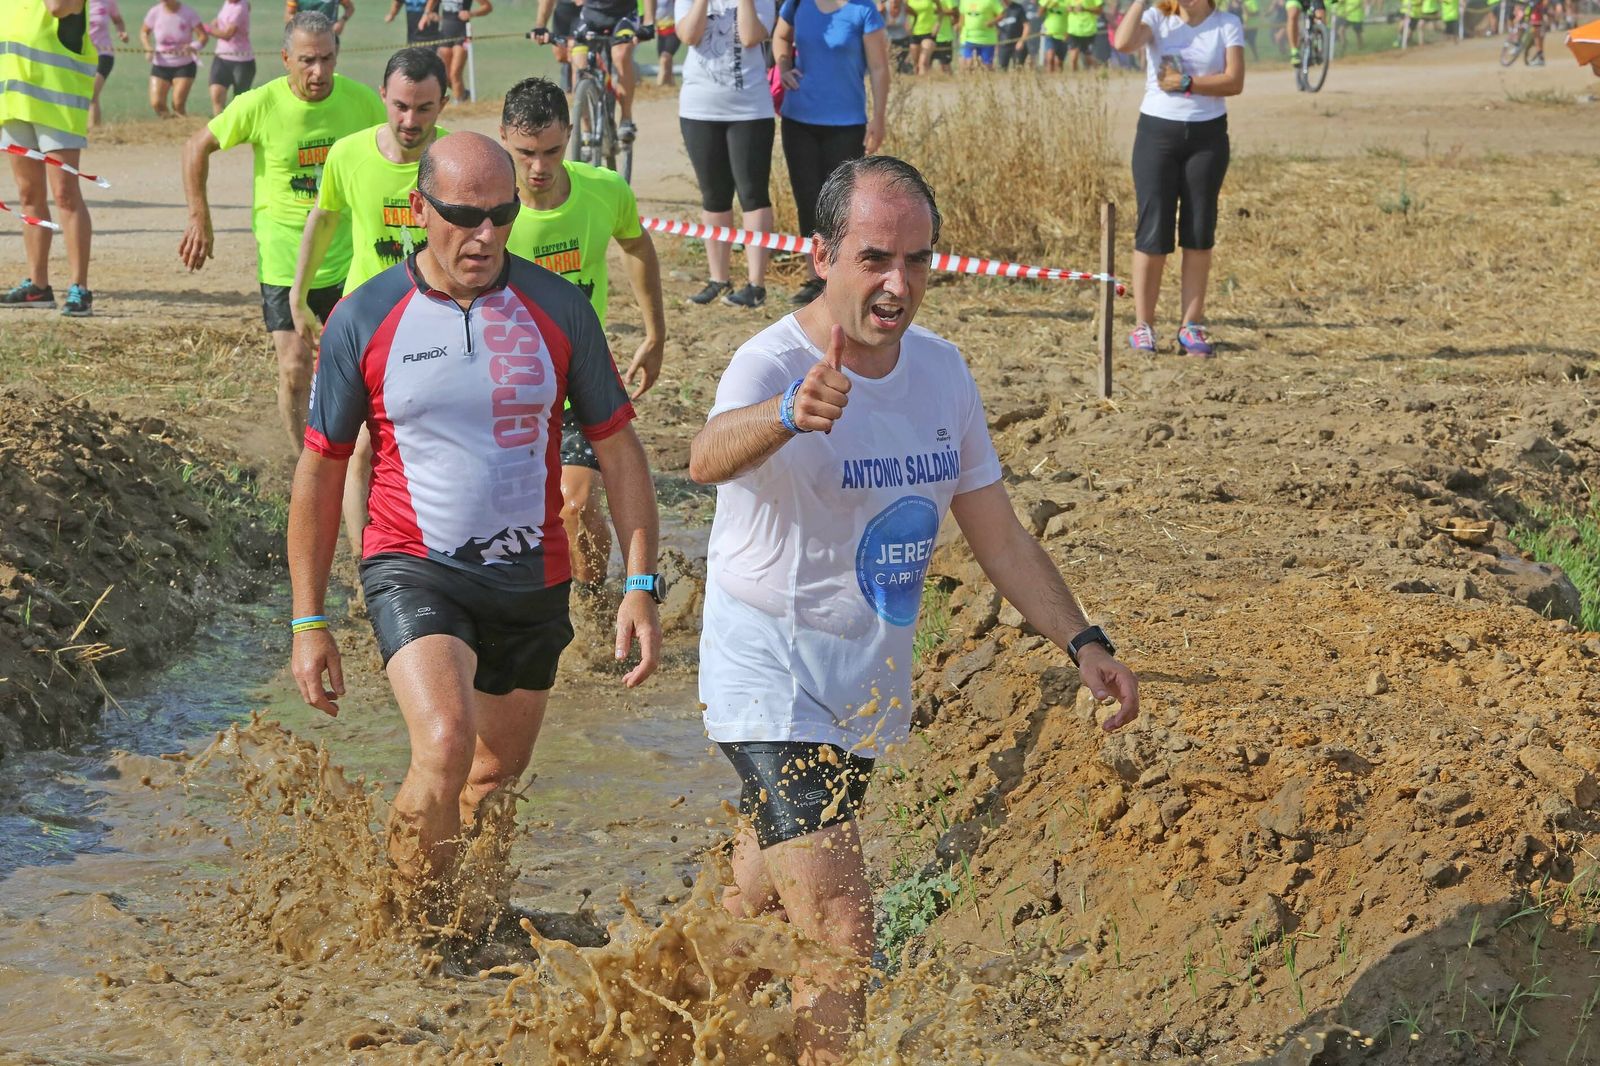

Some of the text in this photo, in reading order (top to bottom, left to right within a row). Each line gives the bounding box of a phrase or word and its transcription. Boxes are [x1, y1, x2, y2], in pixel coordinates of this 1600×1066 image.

[298, 146, 329, 166] BARR
[383, 207, 417, 226] BARR
[841, 457, 903, 489] ANTONIO
[875, 537, 934, 565] JEREZ
[874, 568, 925, 587] CAPPITA
